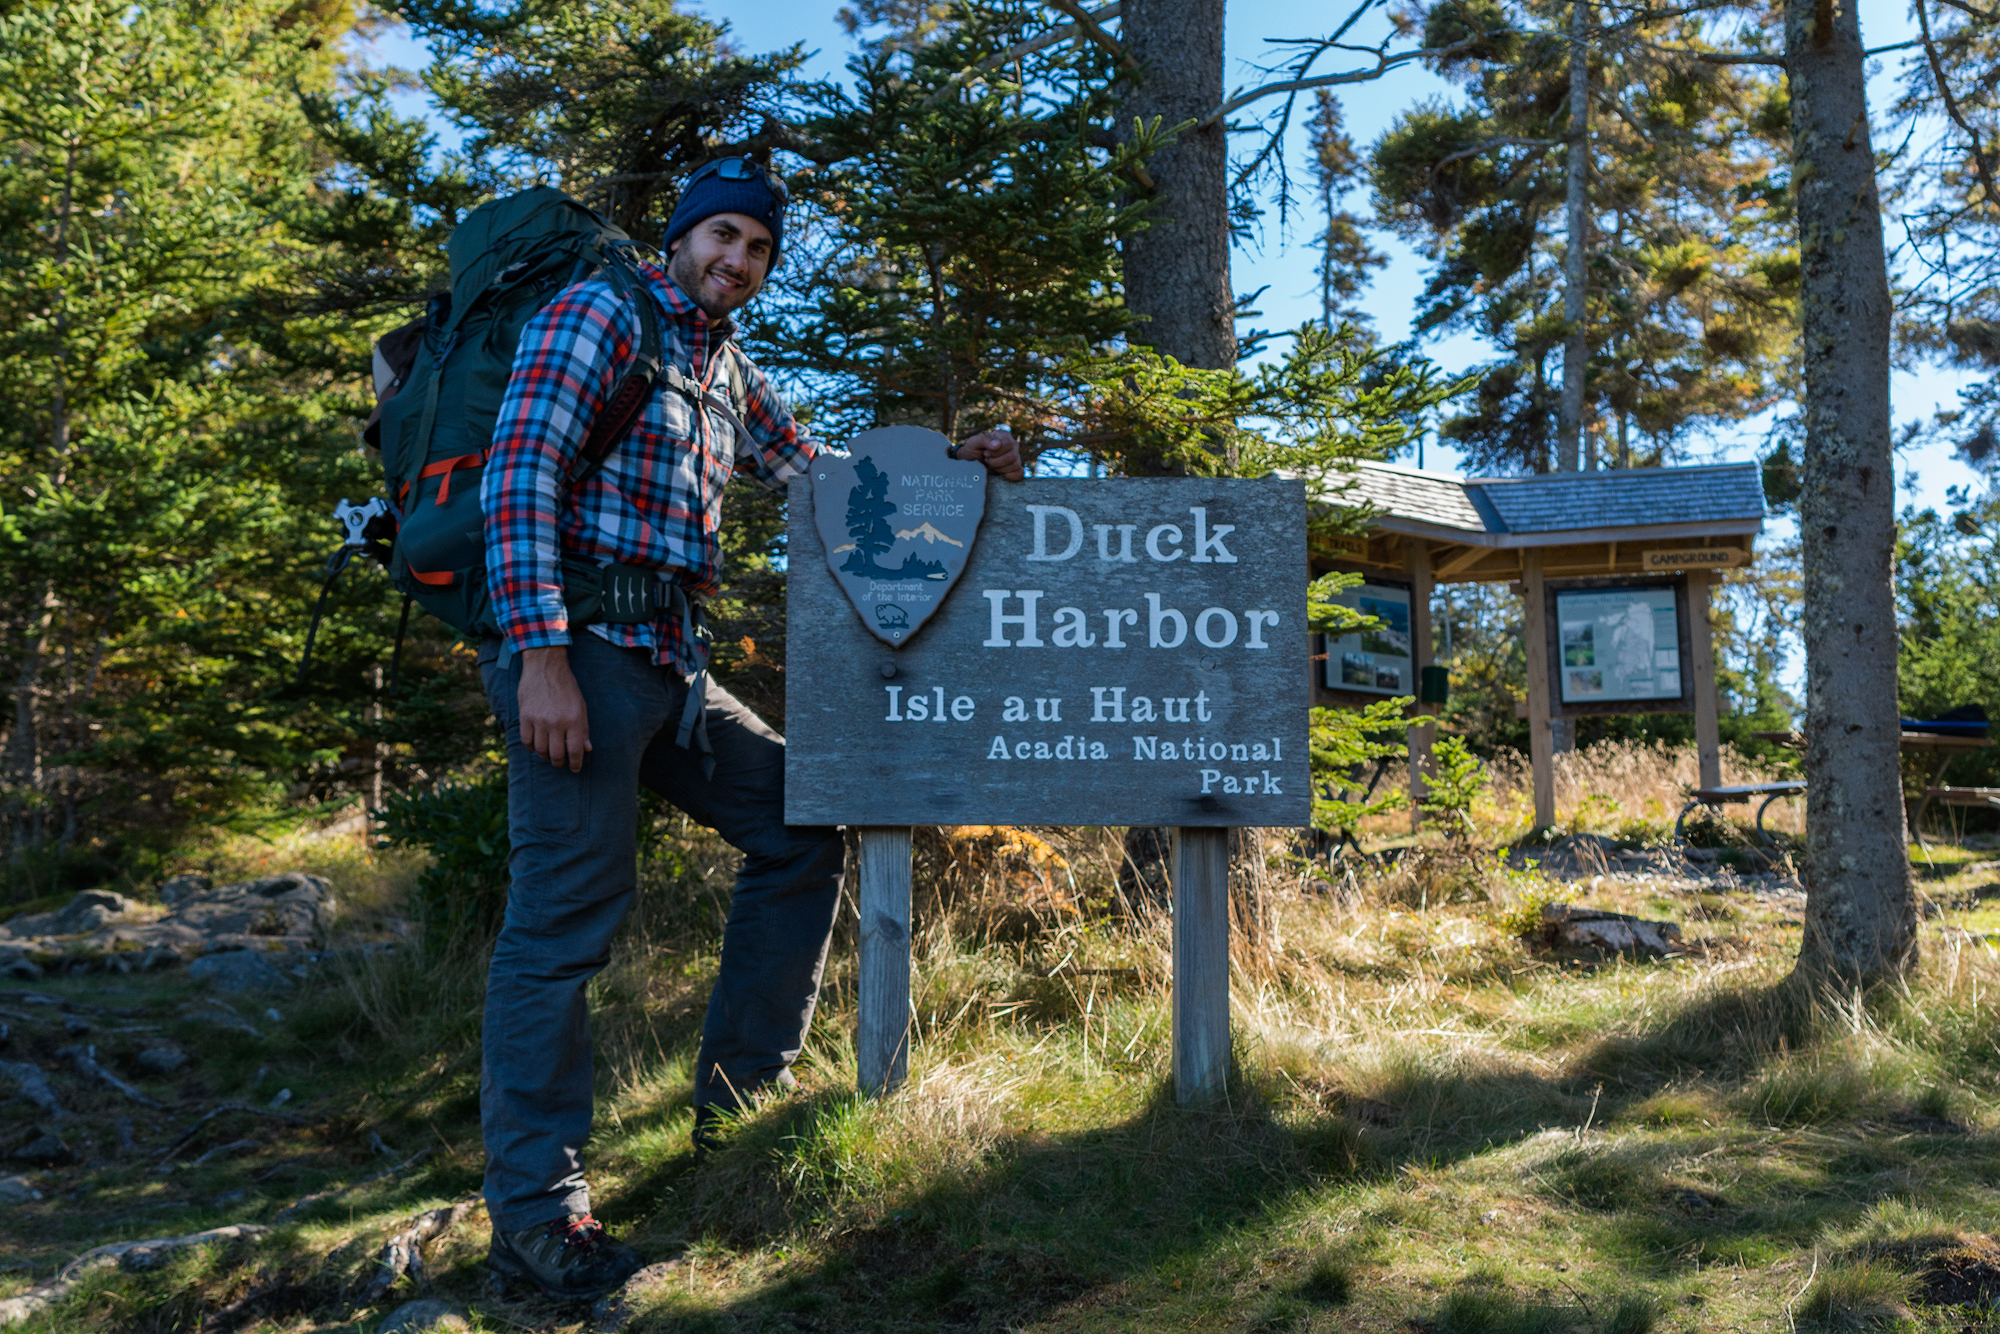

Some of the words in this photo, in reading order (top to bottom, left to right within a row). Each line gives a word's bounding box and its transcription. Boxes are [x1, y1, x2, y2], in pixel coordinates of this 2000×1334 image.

[901, 474, 973, 488] NATIONAL
[915, 488, 954, 502] PARK
[902, 503, 965, 517] SERVICE
[1026, 504, 1238, 563] Duck
[1651, 551, 1729, 566] CAMPGROUND
[869, 581, 924, 593] Department
[862, 592, 873, 602] of
[877, 592, 893, 602] the
[897, 592, 933, 602] Interior
[983, 590, 1280, 649] Harbor
[885, 686, 975, 722] Isle
[1002, 696, 1062, 723] au
[1090, 686, 1212, 723] Haut
[986, 735, 1109, 760] Acadia
[1133, 736, 1283, 762] National
[1200, 768, 1283, 795] Park
